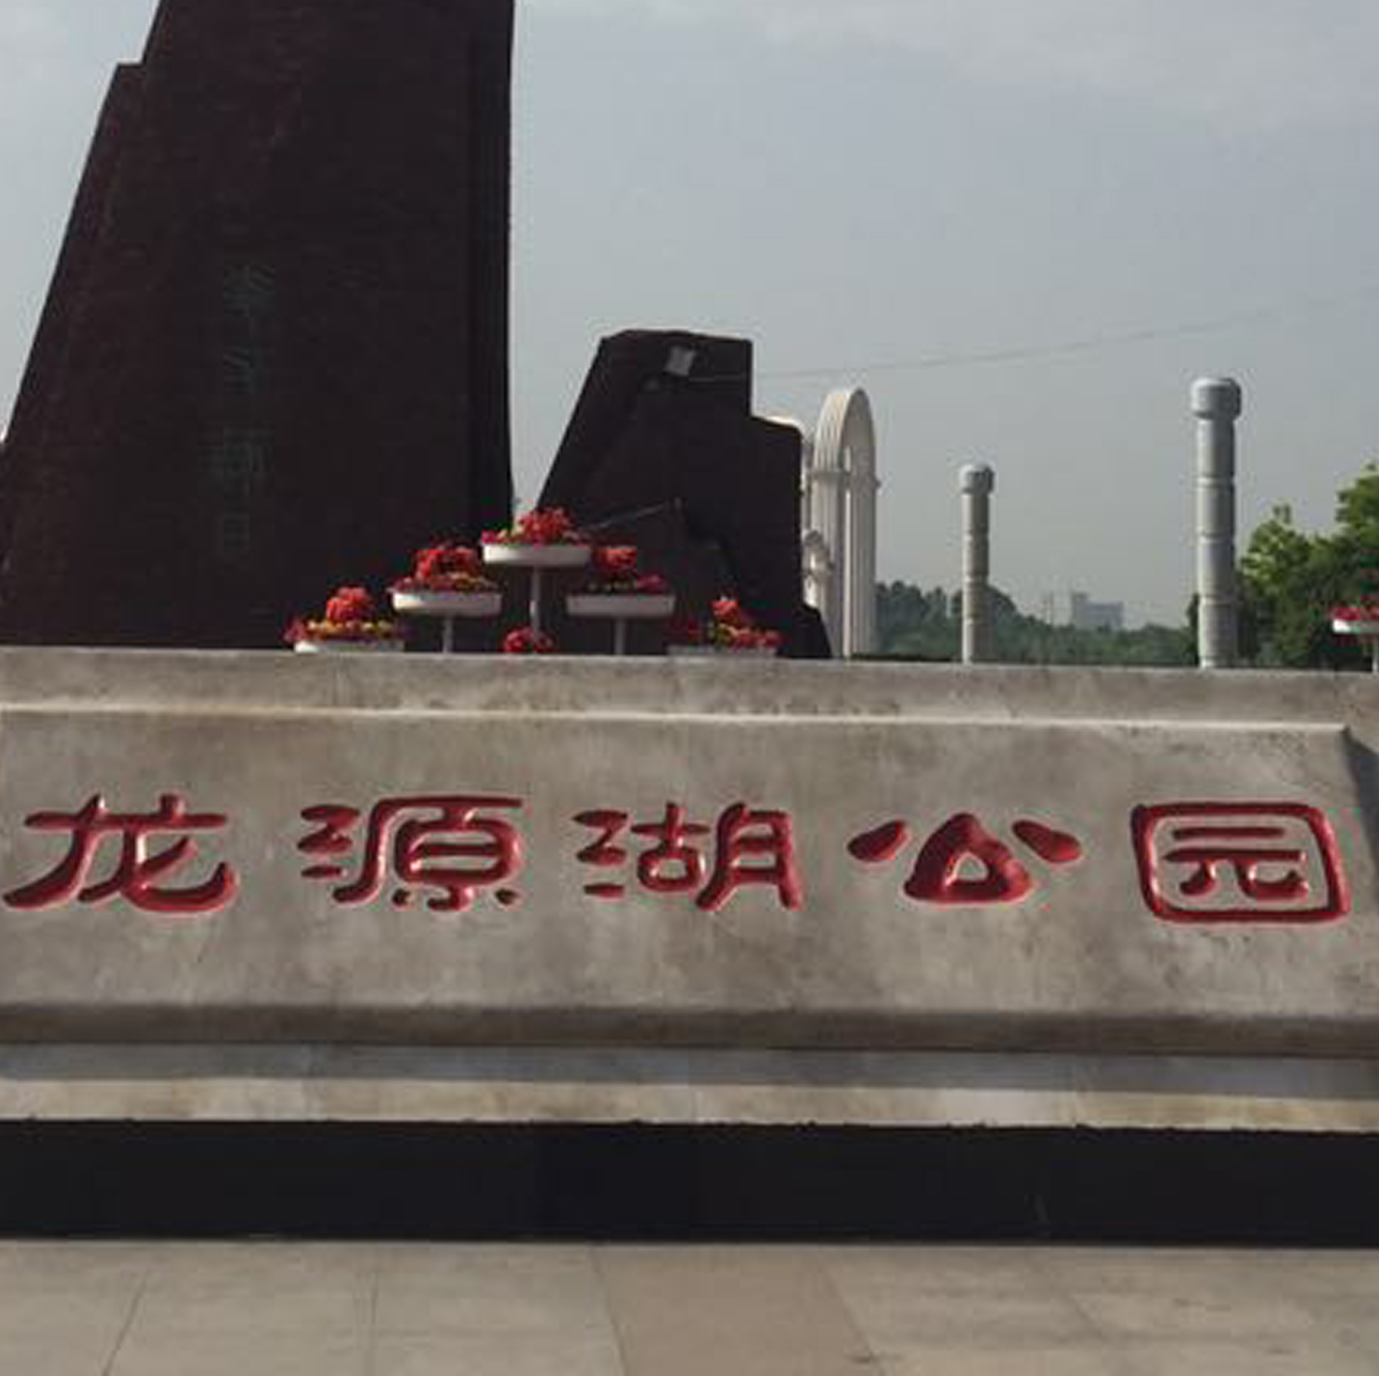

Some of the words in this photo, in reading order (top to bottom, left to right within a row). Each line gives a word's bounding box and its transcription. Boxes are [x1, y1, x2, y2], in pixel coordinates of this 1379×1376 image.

[3, 793, 1352, 924] 龙源湖公园
